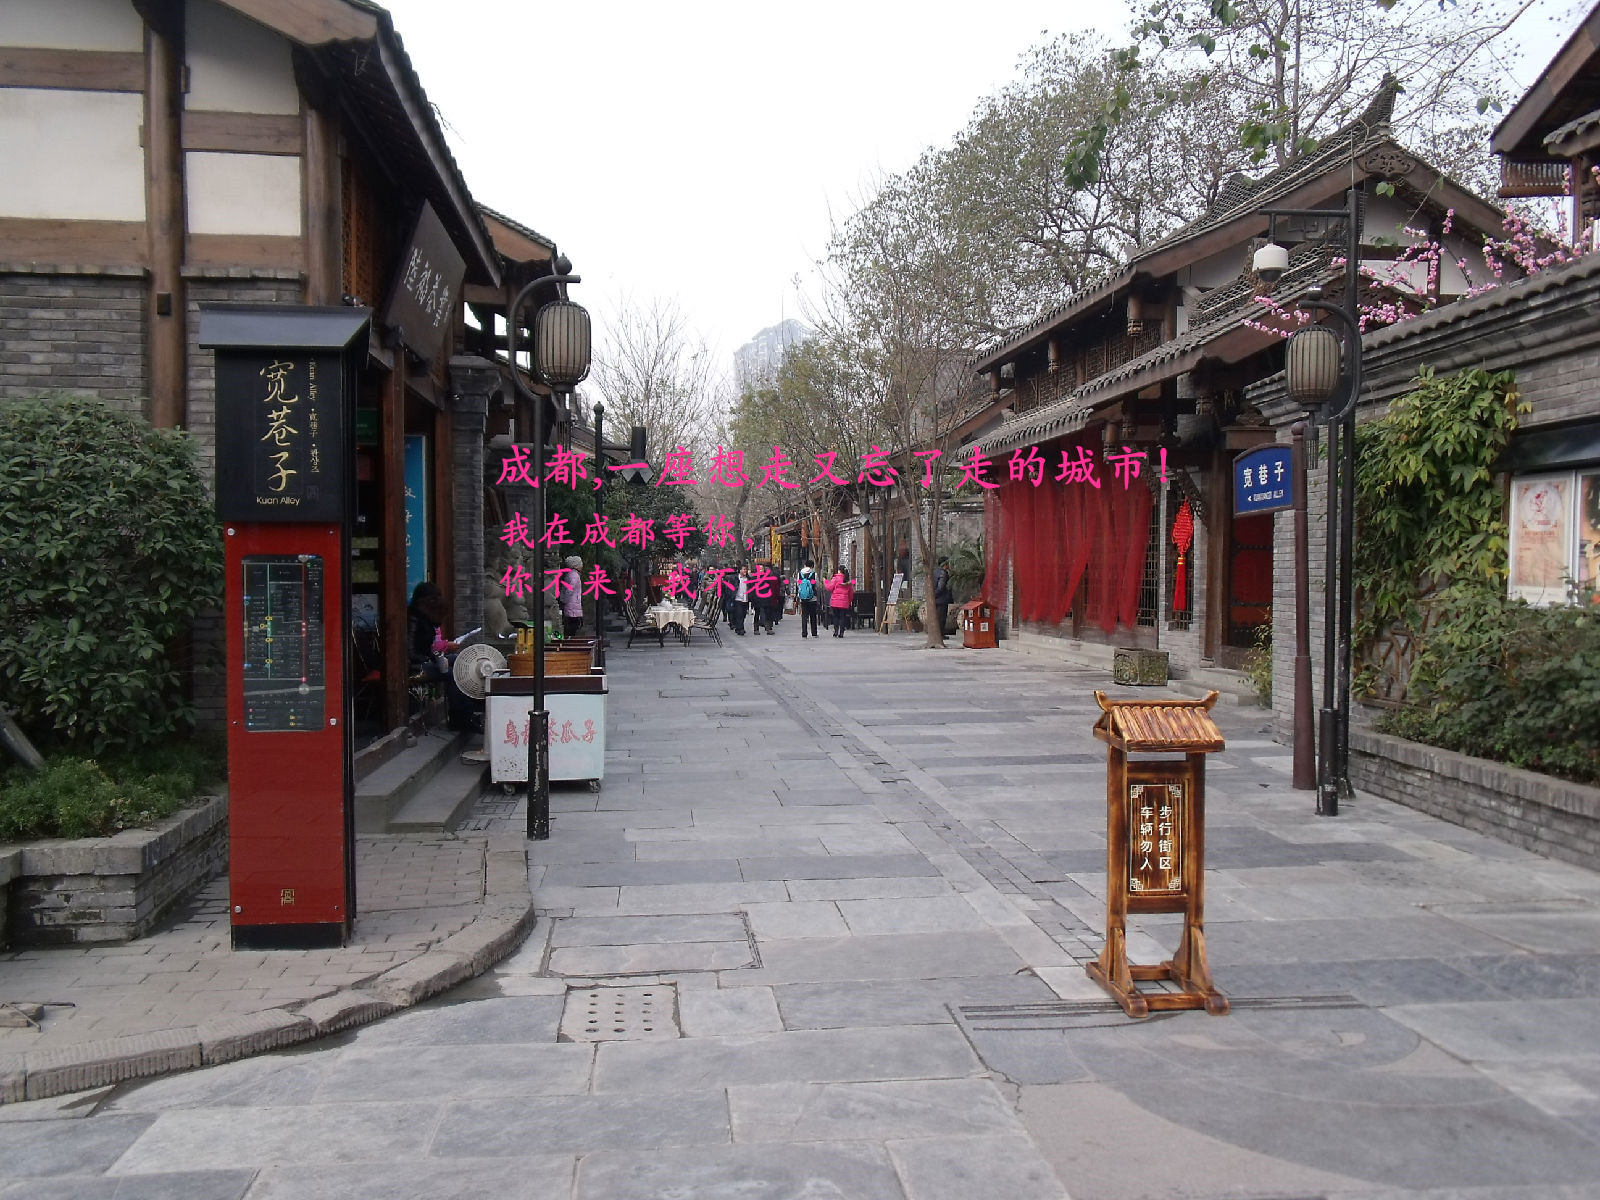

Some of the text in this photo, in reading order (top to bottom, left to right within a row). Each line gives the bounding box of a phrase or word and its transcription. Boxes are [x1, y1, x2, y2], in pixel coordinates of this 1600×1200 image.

[1243, 461, 1285, 488] 宽巷子
[256, 496, 301, 506] Kuan Alley
[1158, 806, 1172, 870] 步行街区
